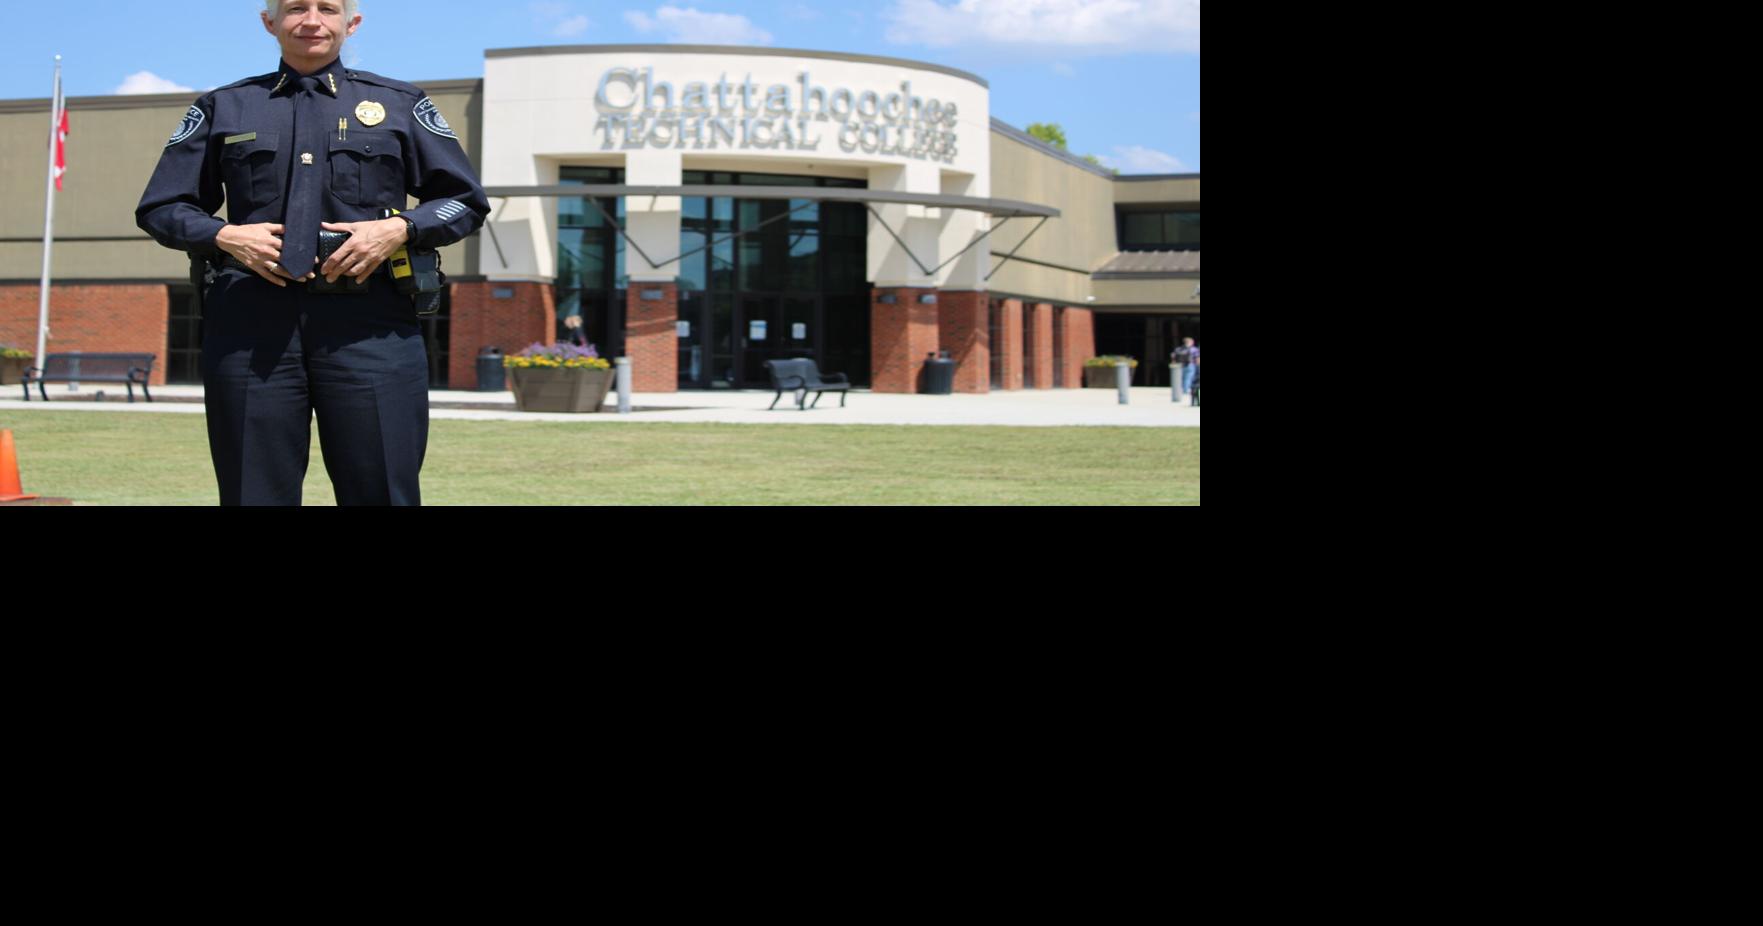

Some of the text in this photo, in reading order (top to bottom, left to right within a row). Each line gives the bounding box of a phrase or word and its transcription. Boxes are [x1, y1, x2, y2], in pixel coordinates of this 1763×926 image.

[595, 66, 957, 126] Chattahoochee
[596, 113, 957, 163] TECHNICAL COLLEGE
